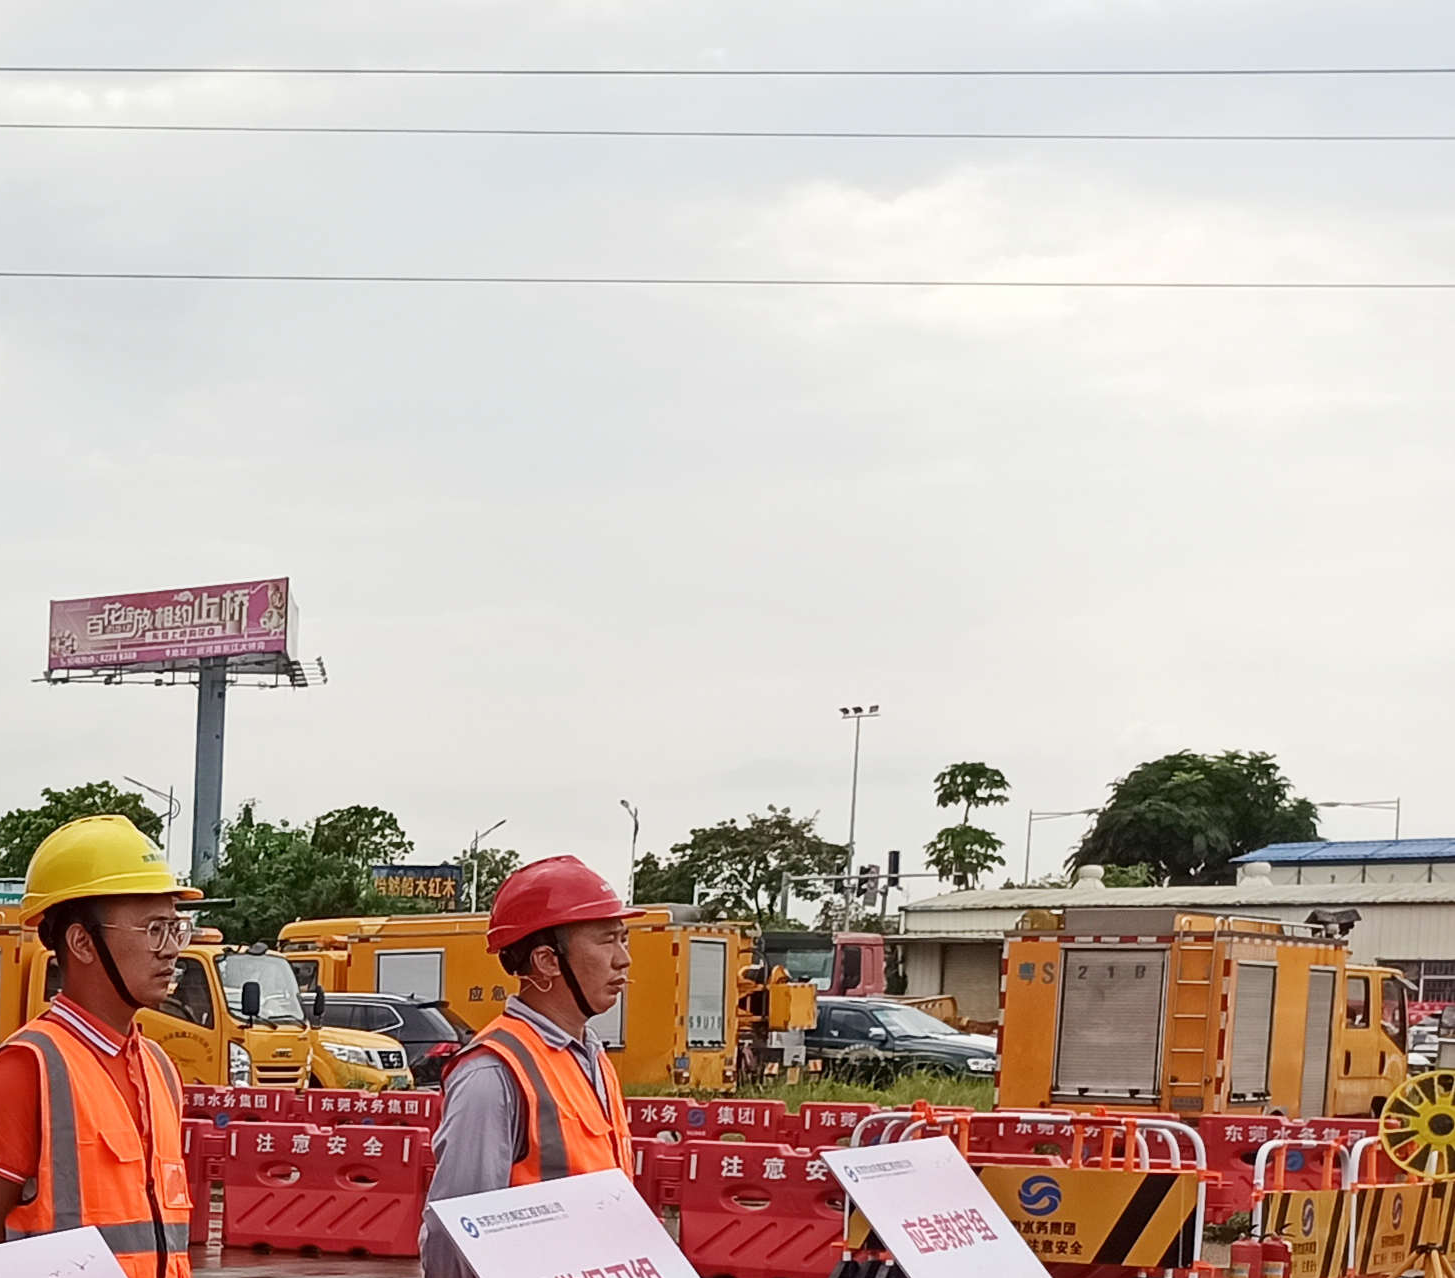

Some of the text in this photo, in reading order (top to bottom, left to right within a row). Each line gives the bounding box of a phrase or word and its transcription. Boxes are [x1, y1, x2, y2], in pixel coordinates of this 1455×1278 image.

[321, 1097, 419, 1114] 东莞水务集团
[641, 1105, 755, 1125] 水务 集团
[256, 1133, 384, 1157] 注意安全
[901, 1208, 999, 1254] 应急救护组
